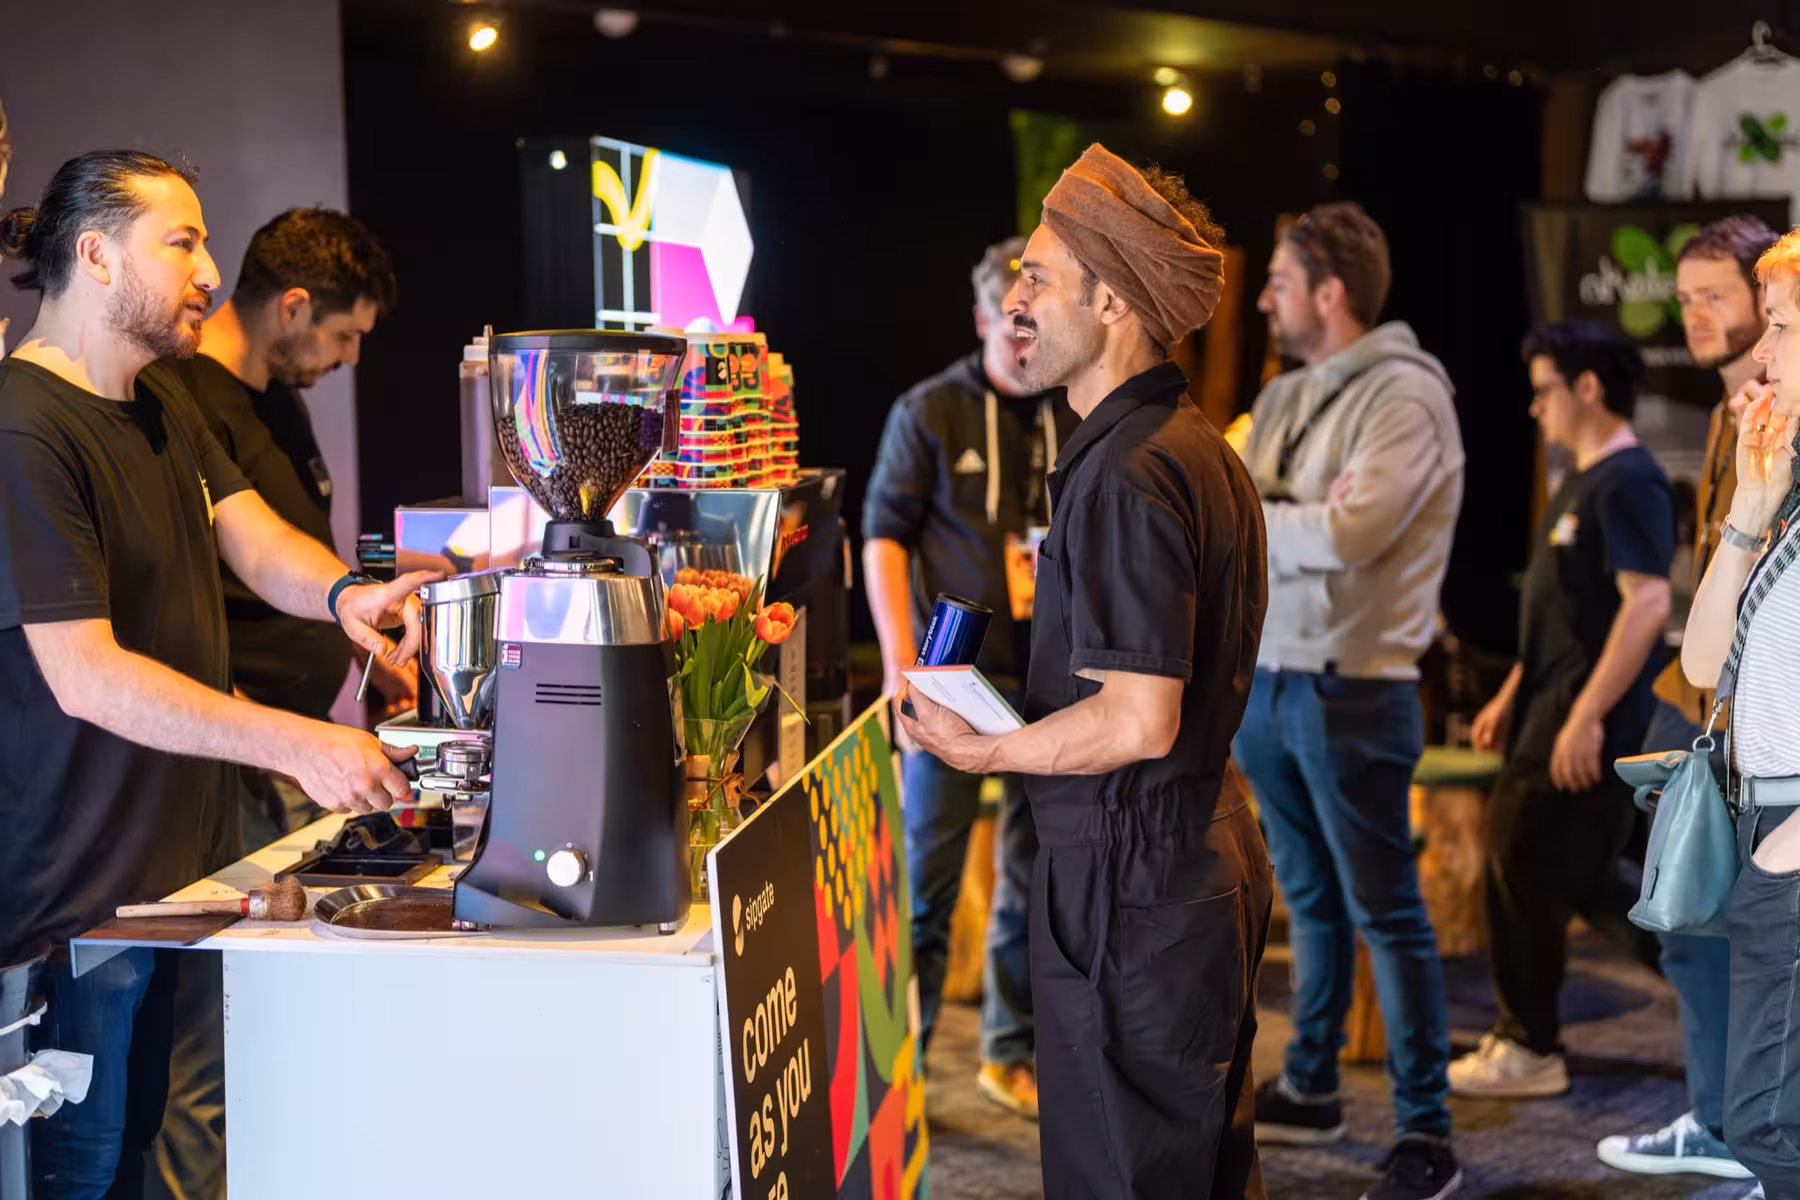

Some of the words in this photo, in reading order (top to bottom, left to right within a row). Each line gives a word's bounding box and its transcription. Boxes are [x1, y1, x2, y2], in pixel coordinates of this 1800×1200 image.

[921, 616, 938, 656] storyblok
[745, 879, 775, 931] sipgate
[742, 966, 797, 1083] come
[749, 1093, 775, 1179] as
[776, 1038, 812, 1157] you
